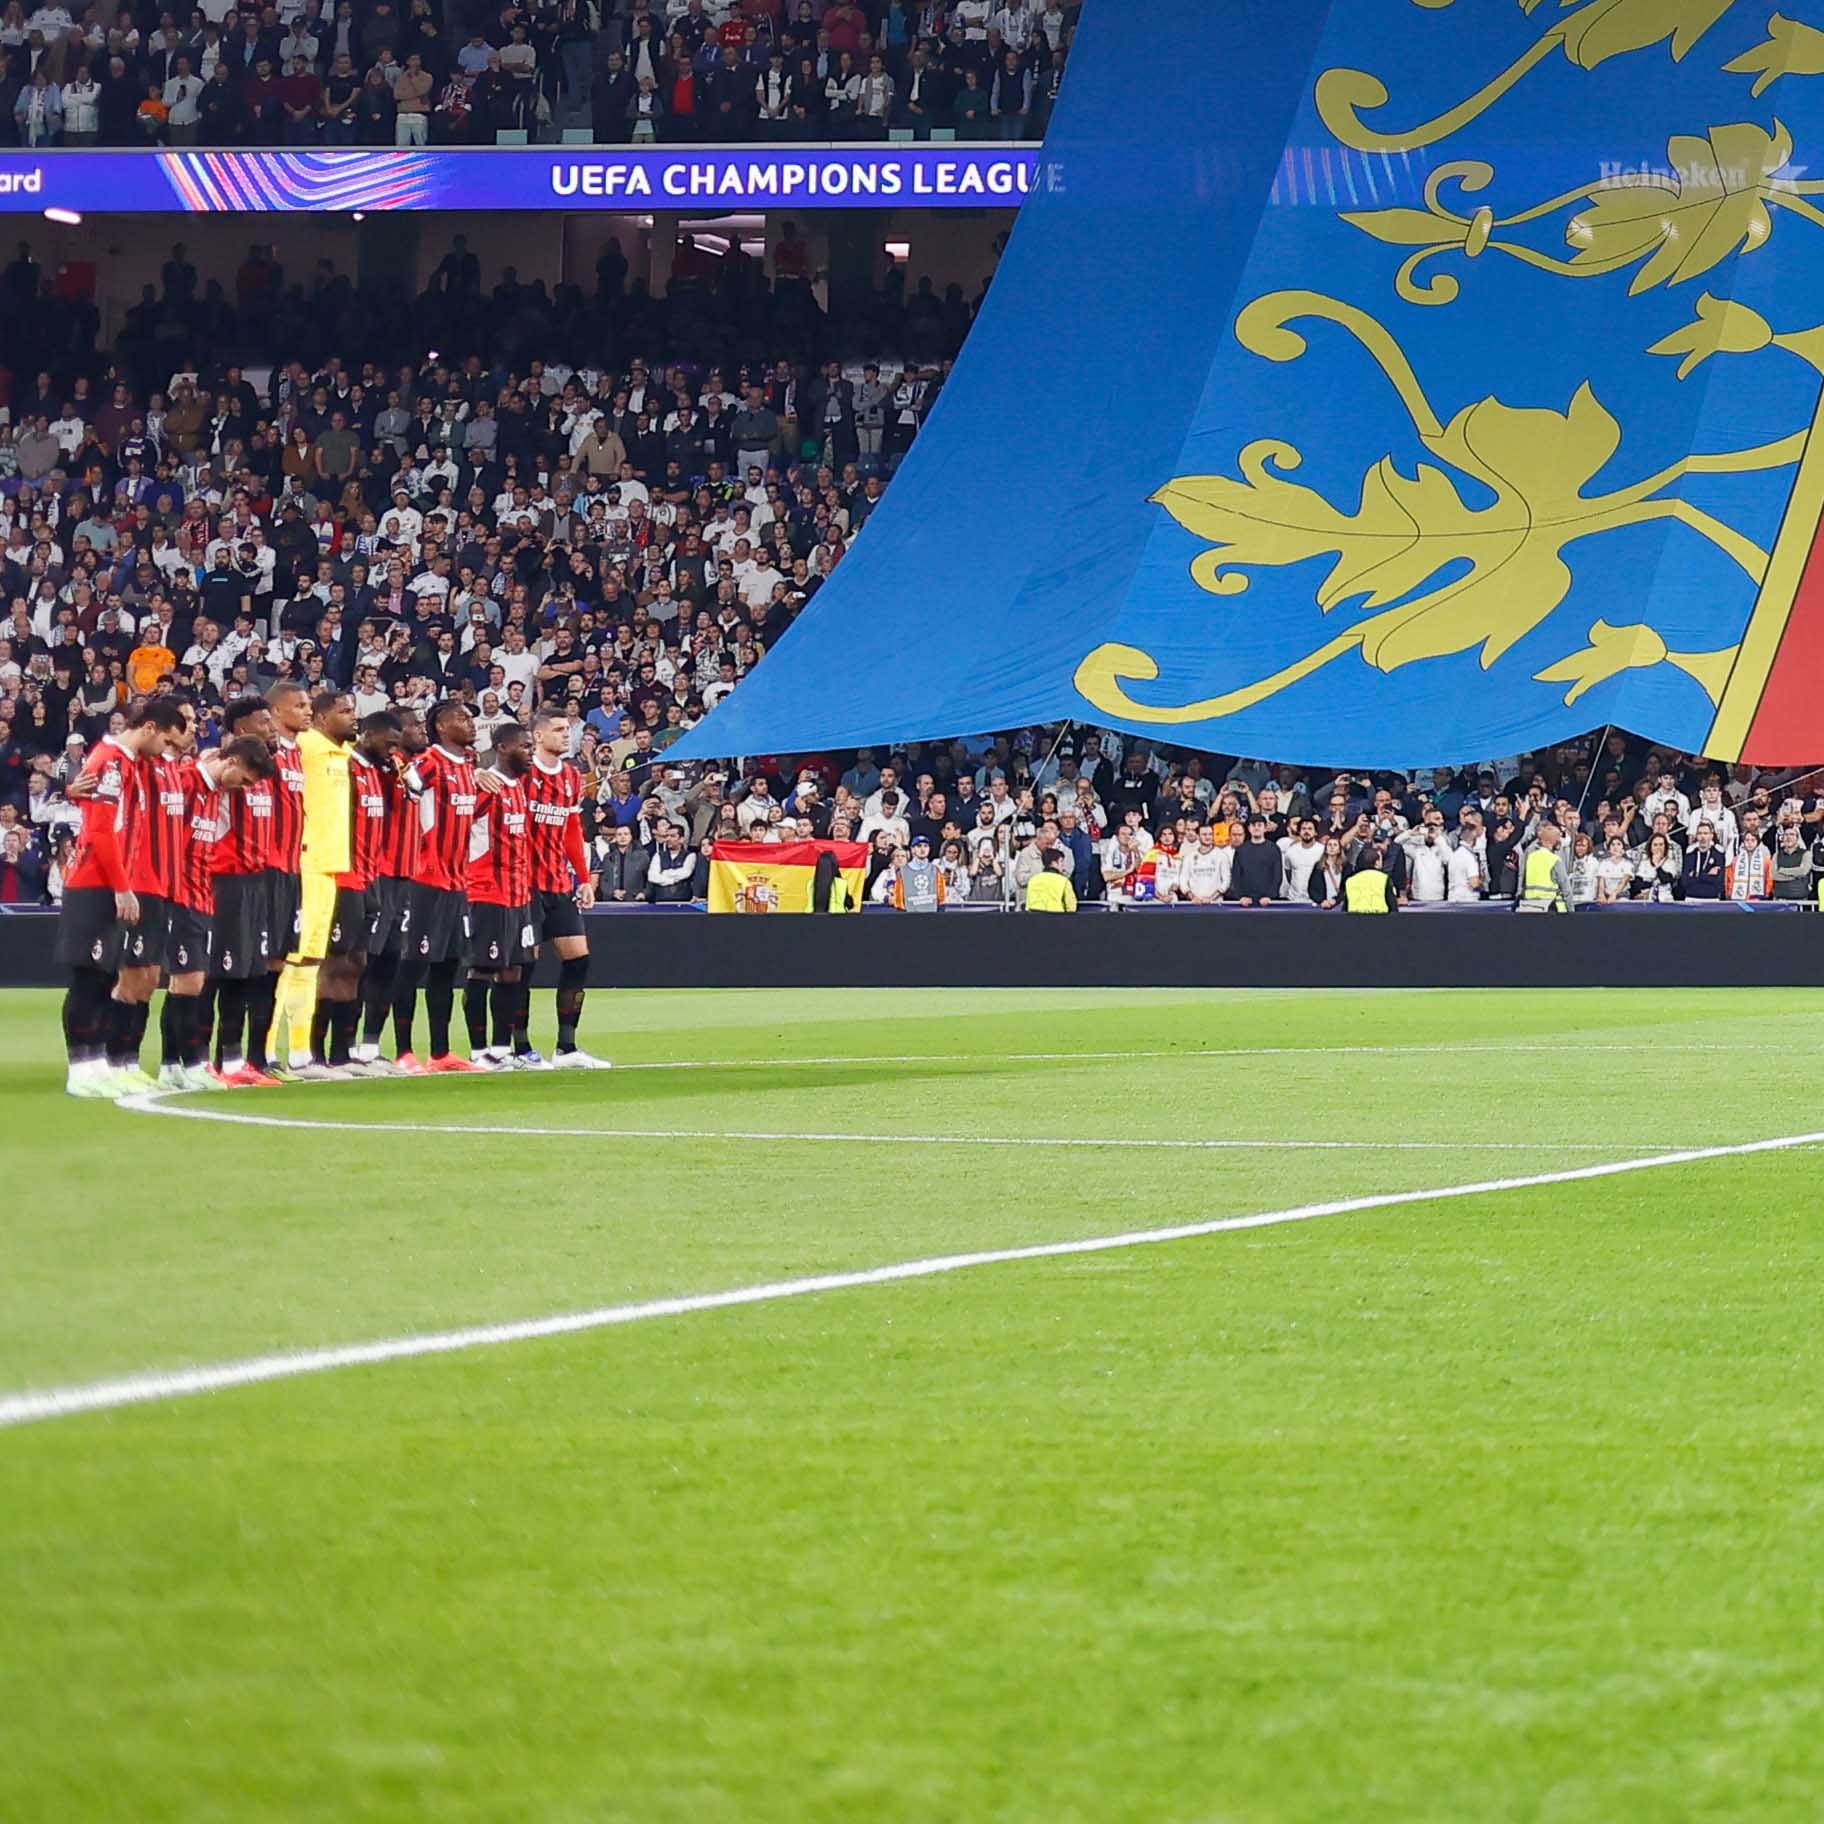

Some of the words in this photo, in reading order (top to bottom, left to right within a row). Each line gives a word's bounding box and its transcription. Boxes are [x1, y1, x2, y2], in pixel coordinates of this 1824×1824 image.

[551, 164, 652, 195] UEFA
[663, 161, 903, 195] CHAMPIONS
[913, 160, 1067, 194] LEAGUE
[1598, 159, 1748, 188] Heineken
